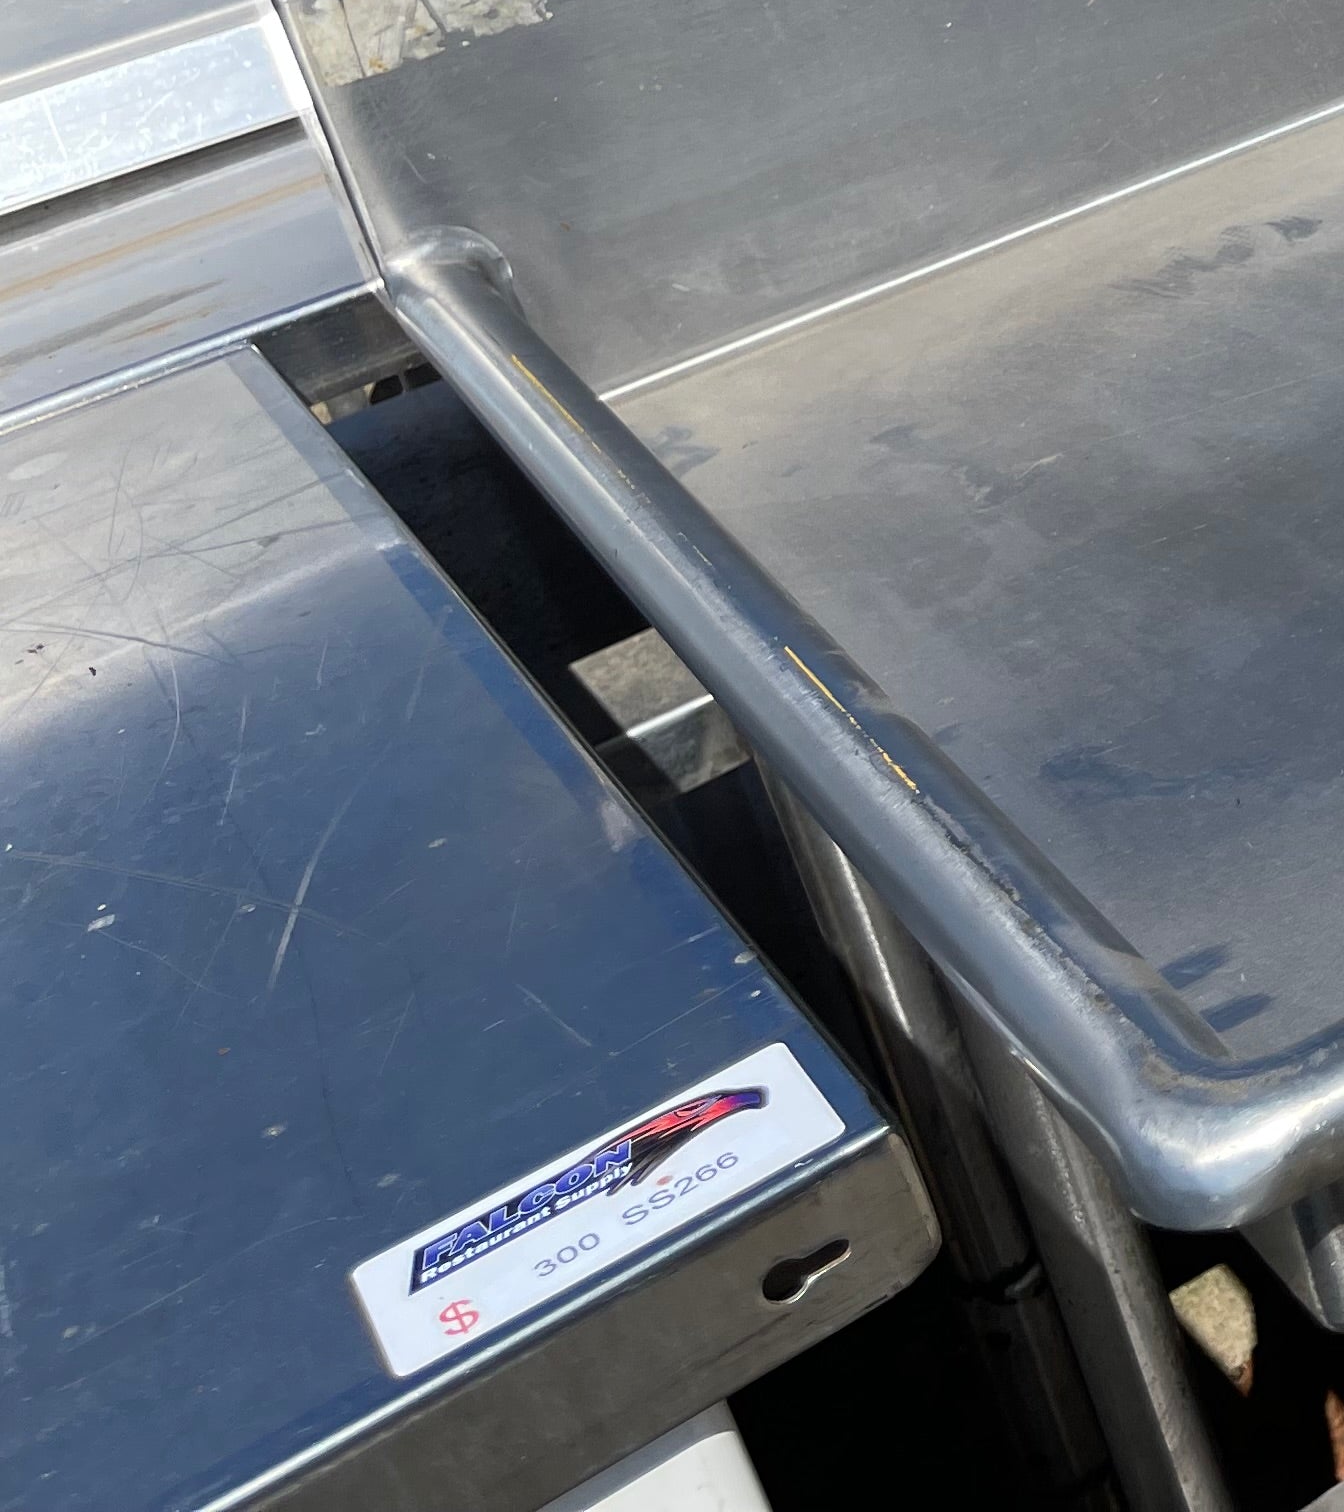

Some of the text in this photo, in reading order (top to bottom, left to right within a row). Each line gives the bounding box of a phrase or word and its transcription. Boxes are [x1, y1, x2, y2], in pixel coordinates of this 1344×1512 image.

[420, 1161, 634, 1284] Restaurant Supply
[421, 1139, 632, 1270] FALCON
[439, 1151, 739, 1336] $ 300 SS266
